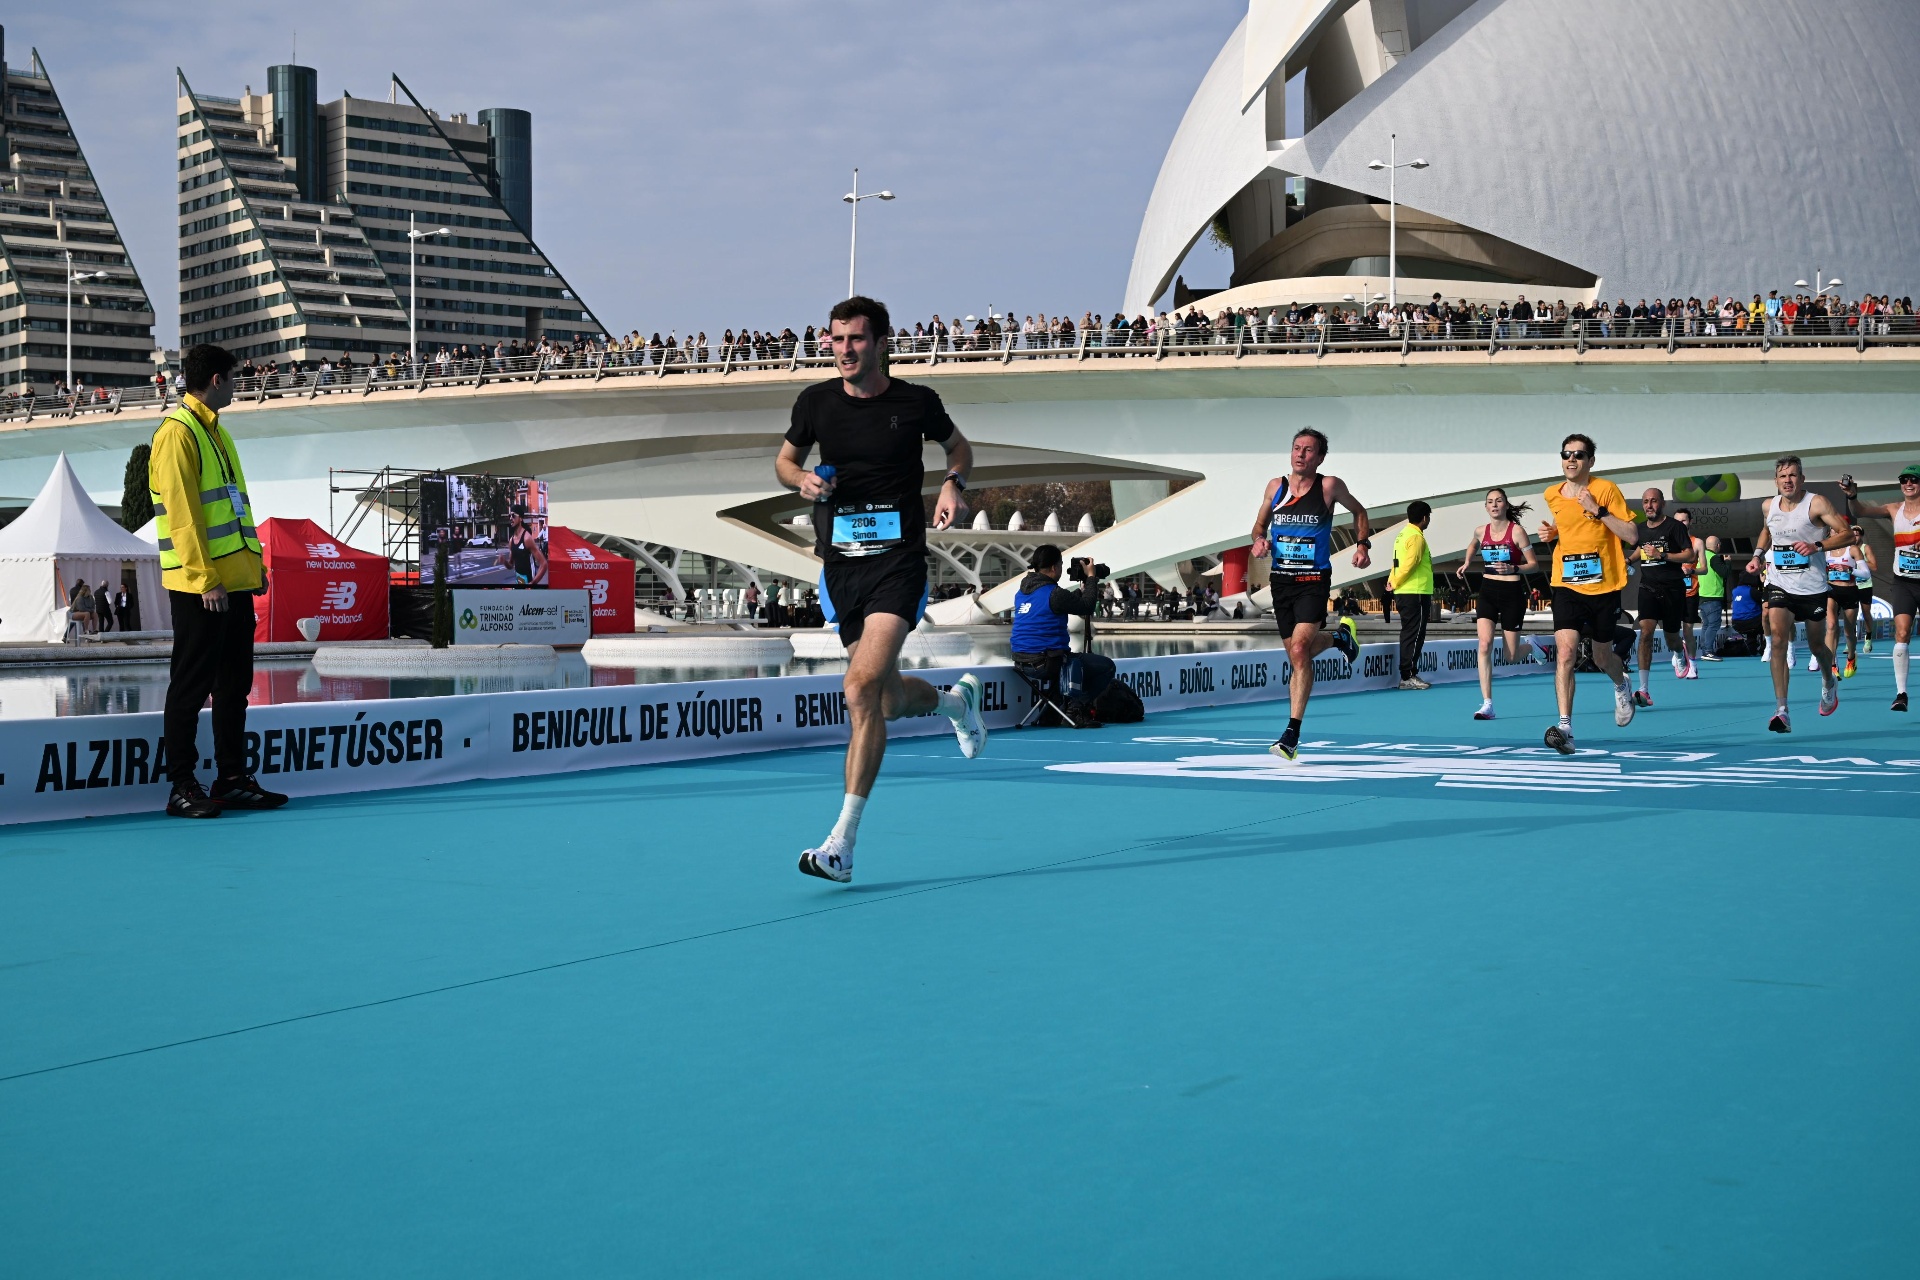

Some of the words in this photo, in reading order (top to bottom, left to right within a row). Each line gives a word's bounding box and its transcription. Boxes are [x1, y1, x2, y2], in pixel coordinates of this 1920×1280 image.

[1691, 507, 1728, 515] RINIDAD
[852, 517, 877, 528] 2806
[1281, 514, 1319, 524] REALITES
[852, 531, 878, 540] Simon
[306, 561, 321, 569] new
[323, 560, 356, 569] balance
[570, 562, 583, 570] new
[584, 562, 609, 570] balance
[592, 608, 617, 617] alance
[314, 615, 331, 624] new
[332, 614, 363, 624] balance
[480, 613, 514, 622] TRINIDAD
[480, 622, 514, 631] ALFONSO
[1417, 651, 1438, 672] ADAU
[1447, 648, 1478, 671] CATARRO
[1179, 662, 1214, 694] BUÑOL
[1231, 663, 1268, 690] CALLES
[1364, 654, 1394, 678] CARLET
[512, 706, 633, 753] BENICULL
[640, 703, 669, 741] DE
[675, 690, 763, 740] XÚQUER
[35, 736, 174, 793] ALZIRA
[243, 711, 443, 775] BENETÚSSER
